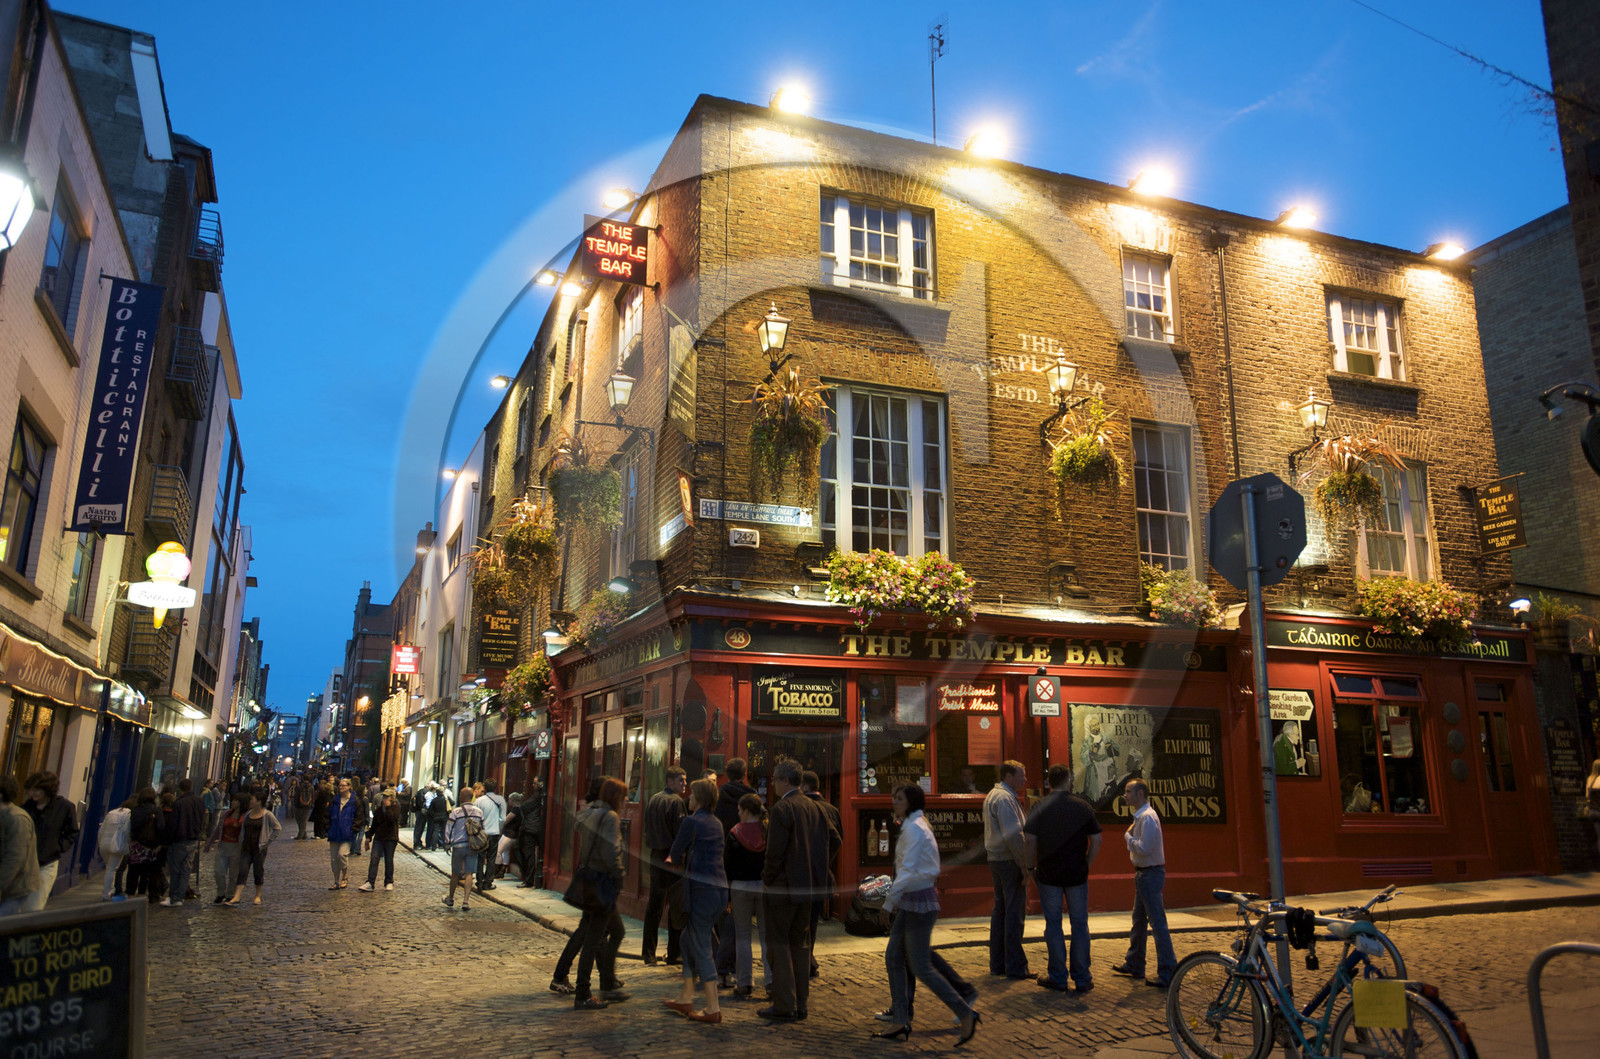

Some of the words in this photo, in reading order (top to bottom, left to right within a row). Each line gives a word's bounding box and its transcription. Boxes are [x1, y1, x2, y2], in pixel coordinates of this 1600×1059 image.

[602, 222, 632, 241] THE
[586, 237, 646, 260] TEMPLE
[601, 258, 632, 276] BAR
[1018, 333, 1062, 355] THE
[88, 286, 138, 498] Botticelli
[1075, 372, 1106, 399] AR
[117, 329, 147, 457] RESTAURANT
[1489, 486, 1501, 494] THE
[1479, 493, 1514, 508] TEMPLE
[87, 505, 117, 516] Nastro
[723, 510, 750, 519] TEMPLE
[751, 513, 770, 521] LANE
[772, 514, 796, 523] SOUTH
[1488, 504, 1507, 516] BAR
[1482, 523, 1496, 531] BEER
[1496, 519, 1517, 528] GARDEN
[1488, 537, 1500, 545] LIVE
[1495, 540, 1510, 548] DAILY
[484, 614, 520, 625] TEMPLE
[490, 620, 511, 630] BAR
[730, 631, 745, 644] 48
[639, 639, 661, 664] BAR
[841, 634, 912, 658] THE
[925, 637, 1052, 663] TEMPLE
[1064, 643, 1126, 667] BAR
[18, 649, 70, 695] Botticelli
[804, 684, 833, 692] SMOKING
[939, 684, 996, 697] Traditional
[767, 687, 833, 711] TOBACCO
[939, 697, 965, 711] Irish
[969, 698, 999, 711] Music
[1281, 693, 1303, 702] Garden
[818, 707, 838, 715] Stock
[1273, 710, 1288, 718] Area
[1098, 712, 1151, 725] TEMPLE
[1114, 724, 1140, 738] BAR
[1189, 723, 1210, 738] THE
[1164, 739, 1212, 755] EMPEROR
[876, 766, 896, 774] LIVE
[898, 766, 922, 774] MUSIC
[1200, 757, 1212, 771] OF
[1148, 779, 1177, 794] ALTED
[1178, 771, 1217, 791] LIQUORS
[926, 811, 965, 824] EMPLE
[9, 928, 83, 959] MEXICO
[13, 957, 38, 978] TO
[45, 943, 101, 973] ROME
[69, 966, 112, 992] BIRD
